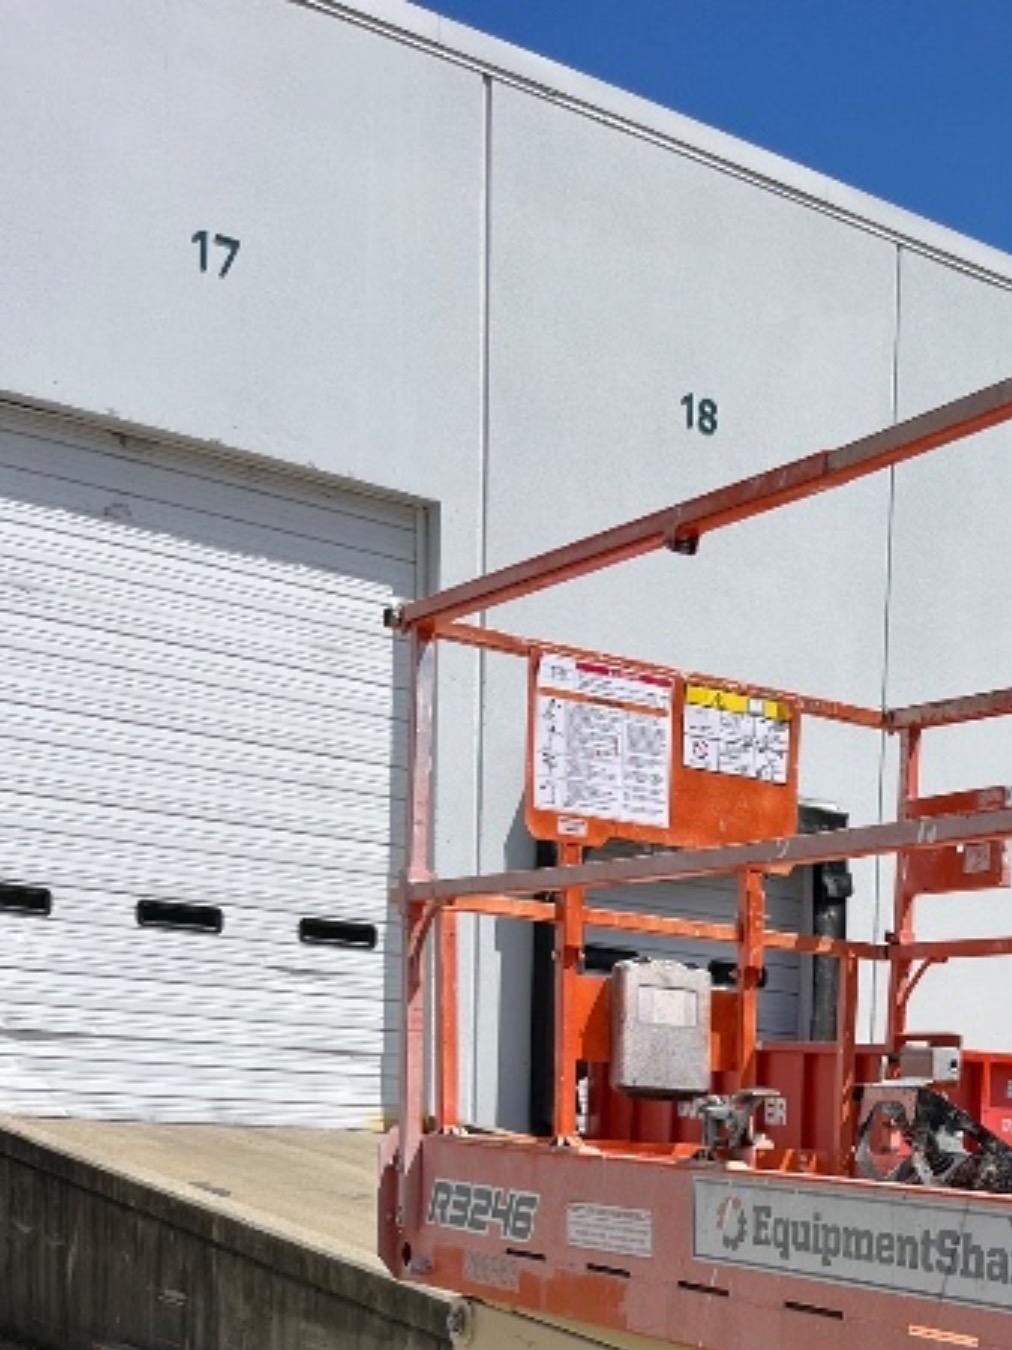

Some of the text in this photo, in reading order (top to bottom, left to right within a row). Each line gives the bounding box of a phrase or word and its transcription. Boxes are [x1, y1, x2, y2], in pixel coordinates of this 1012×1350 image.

[190, 230, 240, 278] 17
[680, 393, 718, 436] 18
[428, 1180, 539, 1240] R3246
